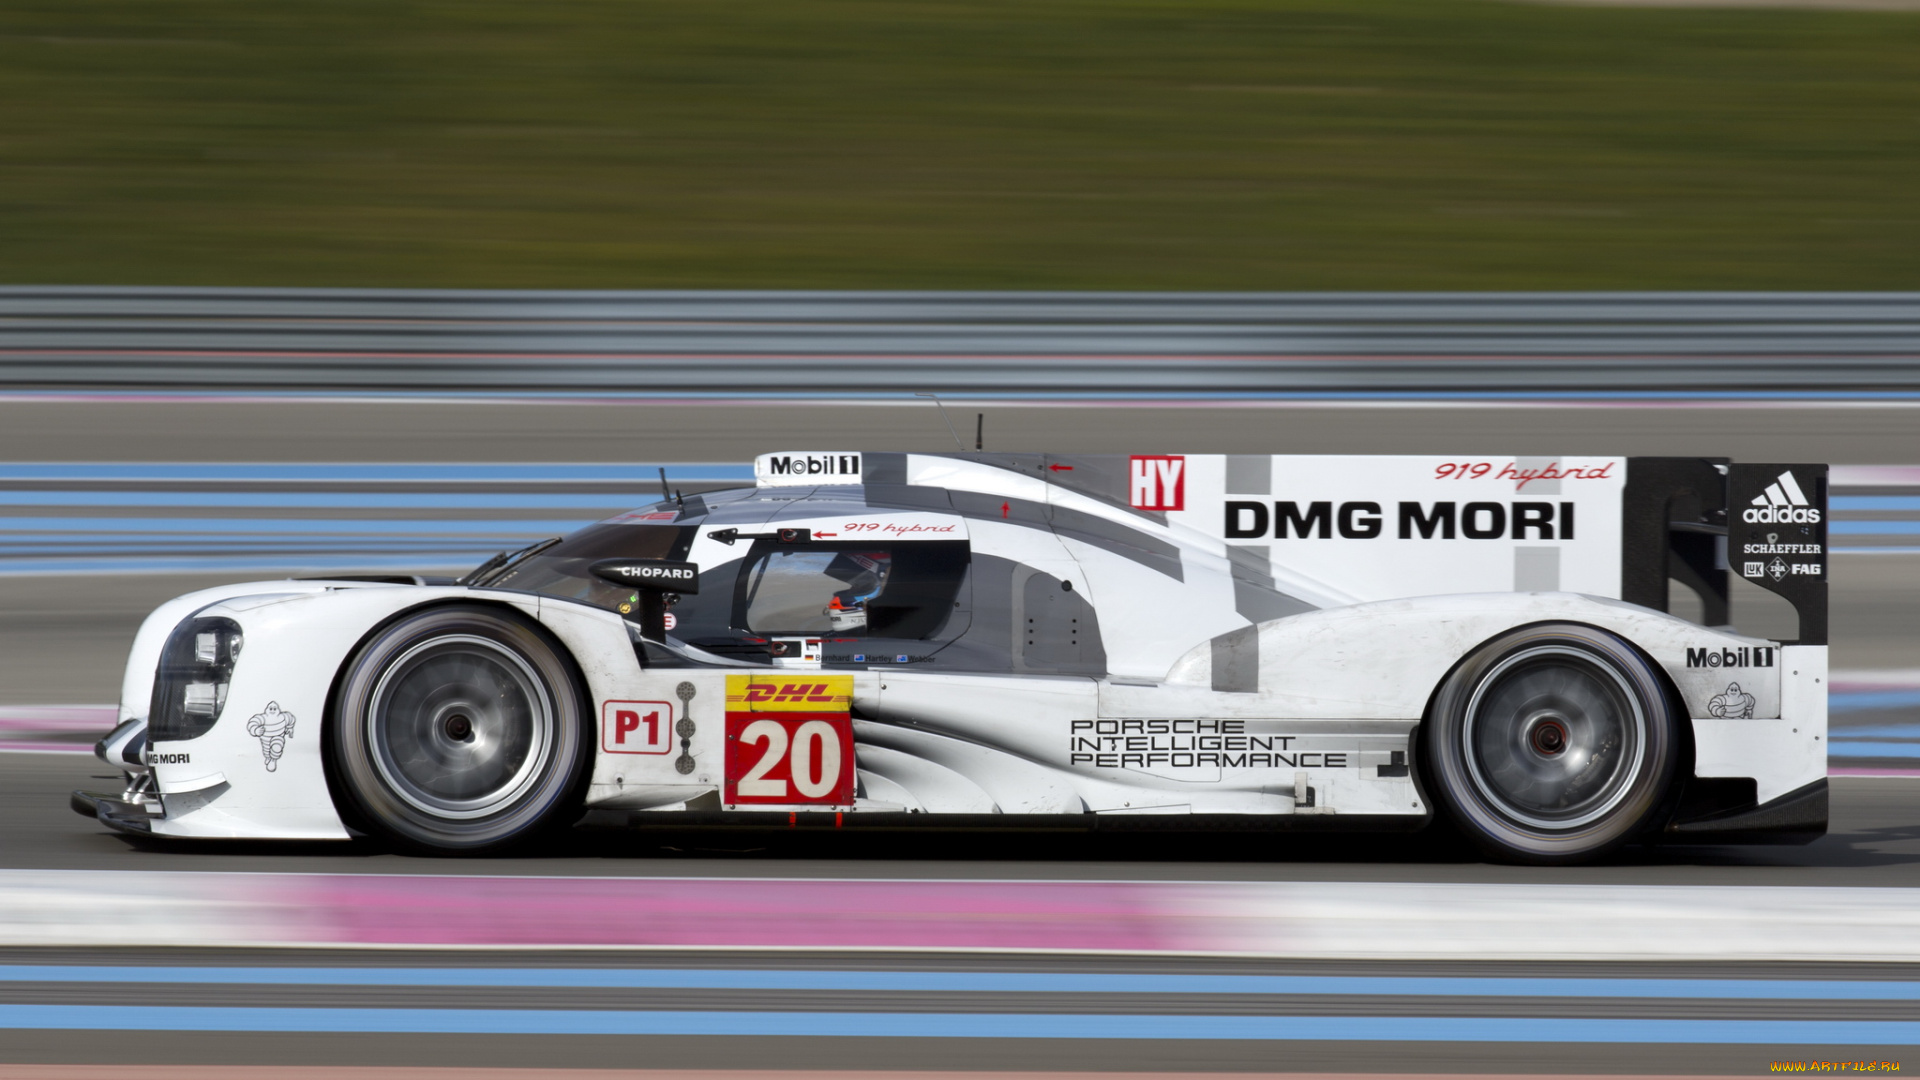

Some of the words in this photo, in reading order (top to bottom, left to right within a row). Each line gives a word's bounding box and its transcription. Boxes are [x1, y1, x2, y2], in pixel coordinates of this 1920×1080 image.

[770, 455, 834, 474] Mobil
[842, 456, 856, 474] 1
[1131, 459, 1183, 507] HY
[1434, 462, 1491, 481] 919
[1493, 462, 1616, 490] hybrid
[1225, 501, 1382, 540] DMG
[1398, 501, 1574, 540] MORI
[1743, 504, 1821, 523] adidas
[844, 523, 880, 532] 919
[882, 523, 956, 537] hybrid
[1744, 544, 1822, 554] SCHAEFFLER
[621, 566, 694, 579] CHOPARD
[1791, 564, 1821, 575] FAG
[815, 654, 850, 662] Bernhard
[866, 654, 892, 664] Hartley
[1686, 647, 1749, 668] Mobil
[1756, 647, 1770, 667] 1
[743, 684, 836, 702] DHL
[615, 710, 659, 745] P1
[1071, 720, 1245, 735] PORSCHE
[1071, 736, 1296, 751] INTELLIGENT
[147, 753, 159, 764] MG
[159, 753, 190, 764] MORI
[737, 720, 841, 798] 20
[1071, 753, 1347, 768] PERFORMANCE
